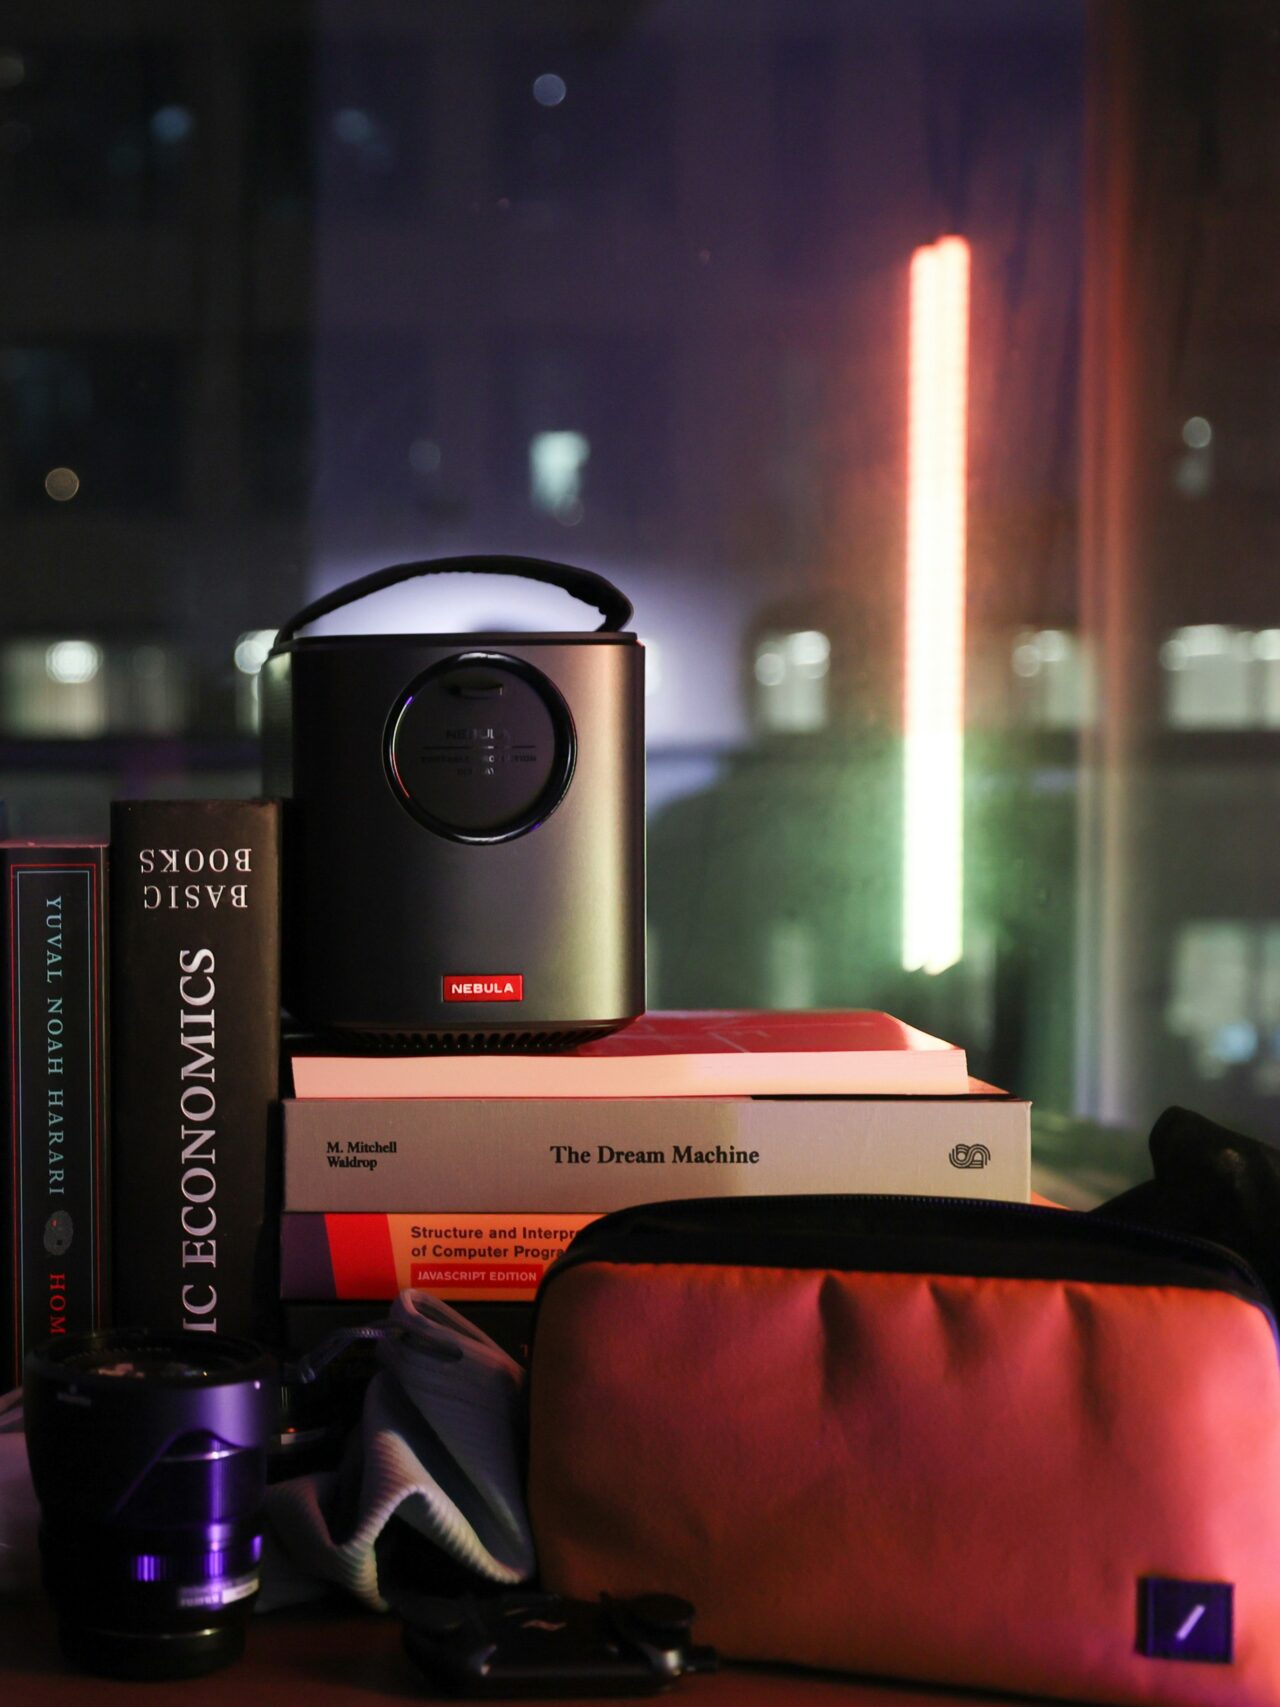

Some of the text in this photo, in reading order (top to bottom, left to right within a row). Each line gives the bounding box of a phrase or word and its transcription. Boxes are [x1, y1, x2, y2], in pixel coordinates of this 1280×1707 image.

[140, 848, 253, 874] BOOKS
[144, 883, 248, 909] BASIC
[450, 982, 515, 995] NEBULA
[45, 895, 65, 1196] YUVAL NOAH HARARI
[179, 947, 219, 1268] ECONOMICS
[326, 1141, 398, 1154] M. Mitchell
[550, 1145, 761, 1165] The Dream Machine
[326, 1156, 378, 1170] Waldrop
[410, 1226, 484, 1239] Structure
[489, 1227, 517, 1239] and
[411, 1245, 428, 1257] of
[432, 1245, 508, 1260] Computer
[417, 1271, 538, 1282] JAVASCRIPT EDITION
